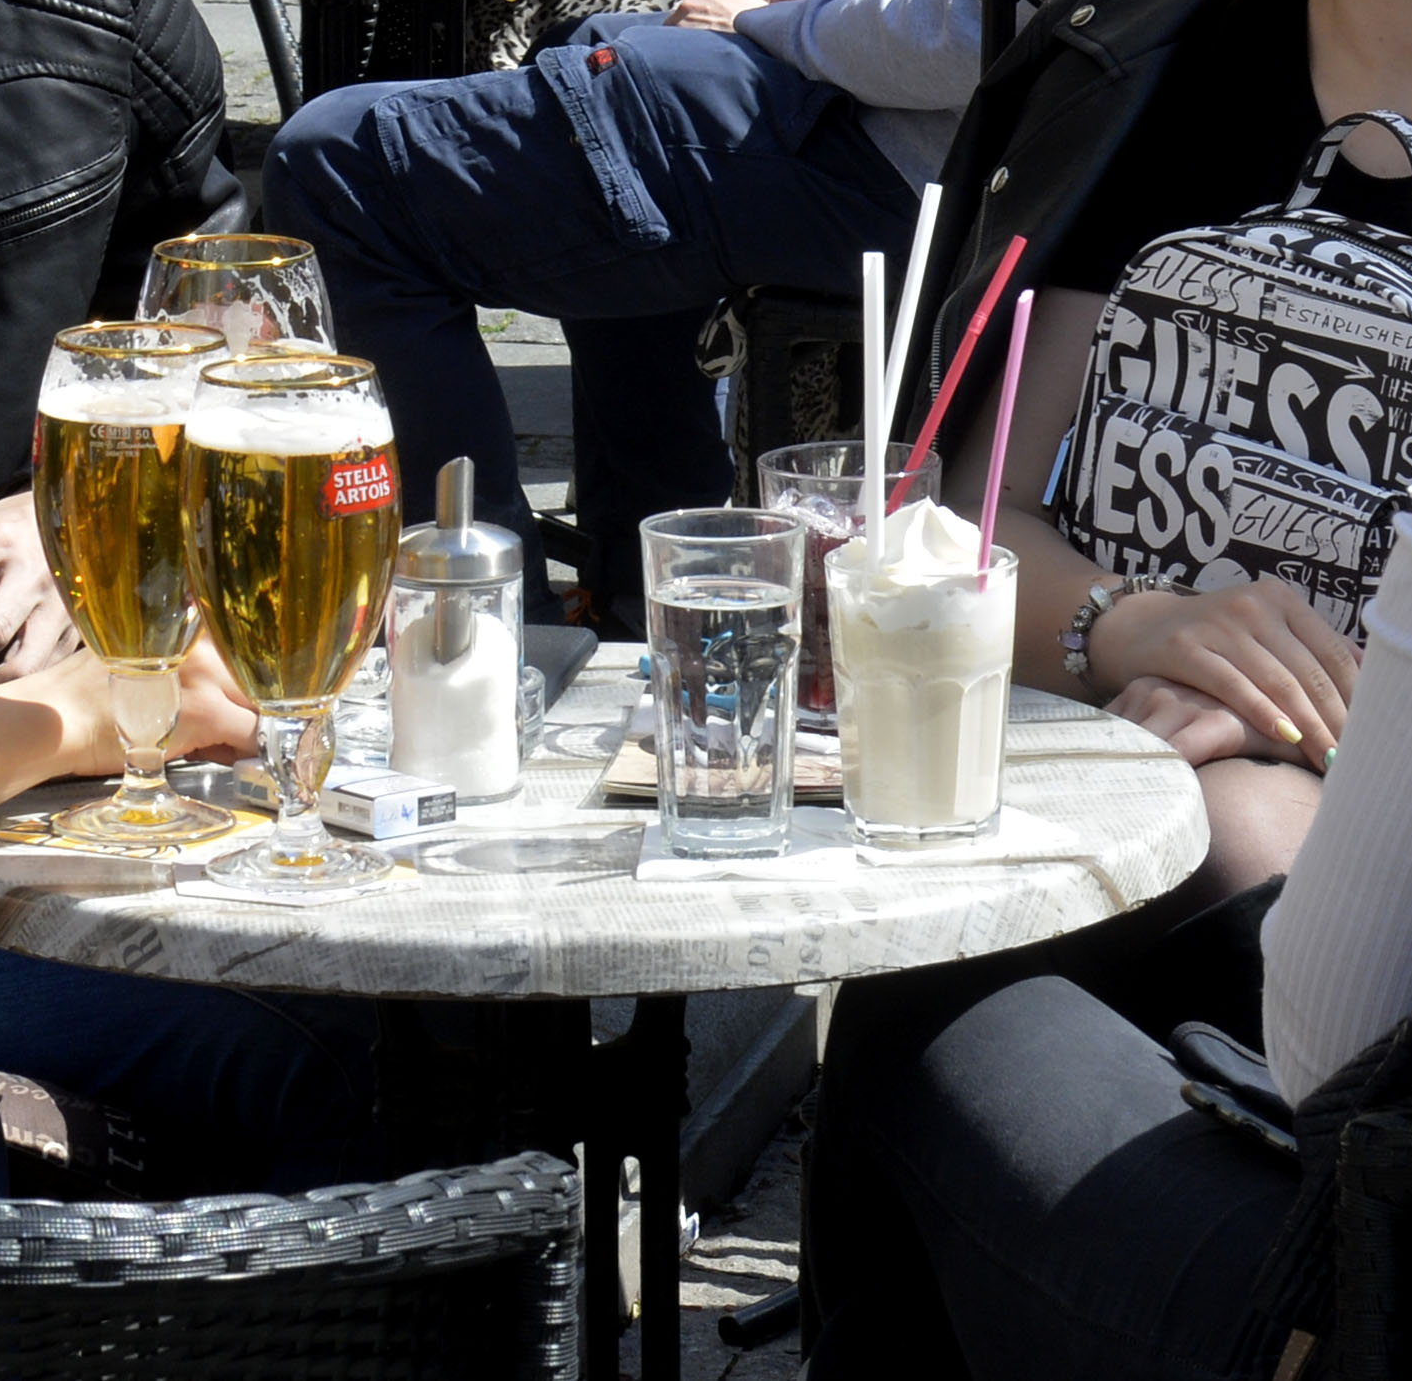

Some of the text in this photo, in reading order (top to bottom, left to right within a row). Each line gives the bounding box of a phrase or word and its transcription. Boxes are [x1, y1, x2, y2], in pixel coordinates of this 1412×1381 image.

[1172, 309, 1277, 353] GUESS
[1107, 305, 1385, 486] GUESS
[333, 463, 389, 489] STELLA
[335, 480, 391, 507] ARTOIS
[1233, 494, 1356, 563] GUESS
